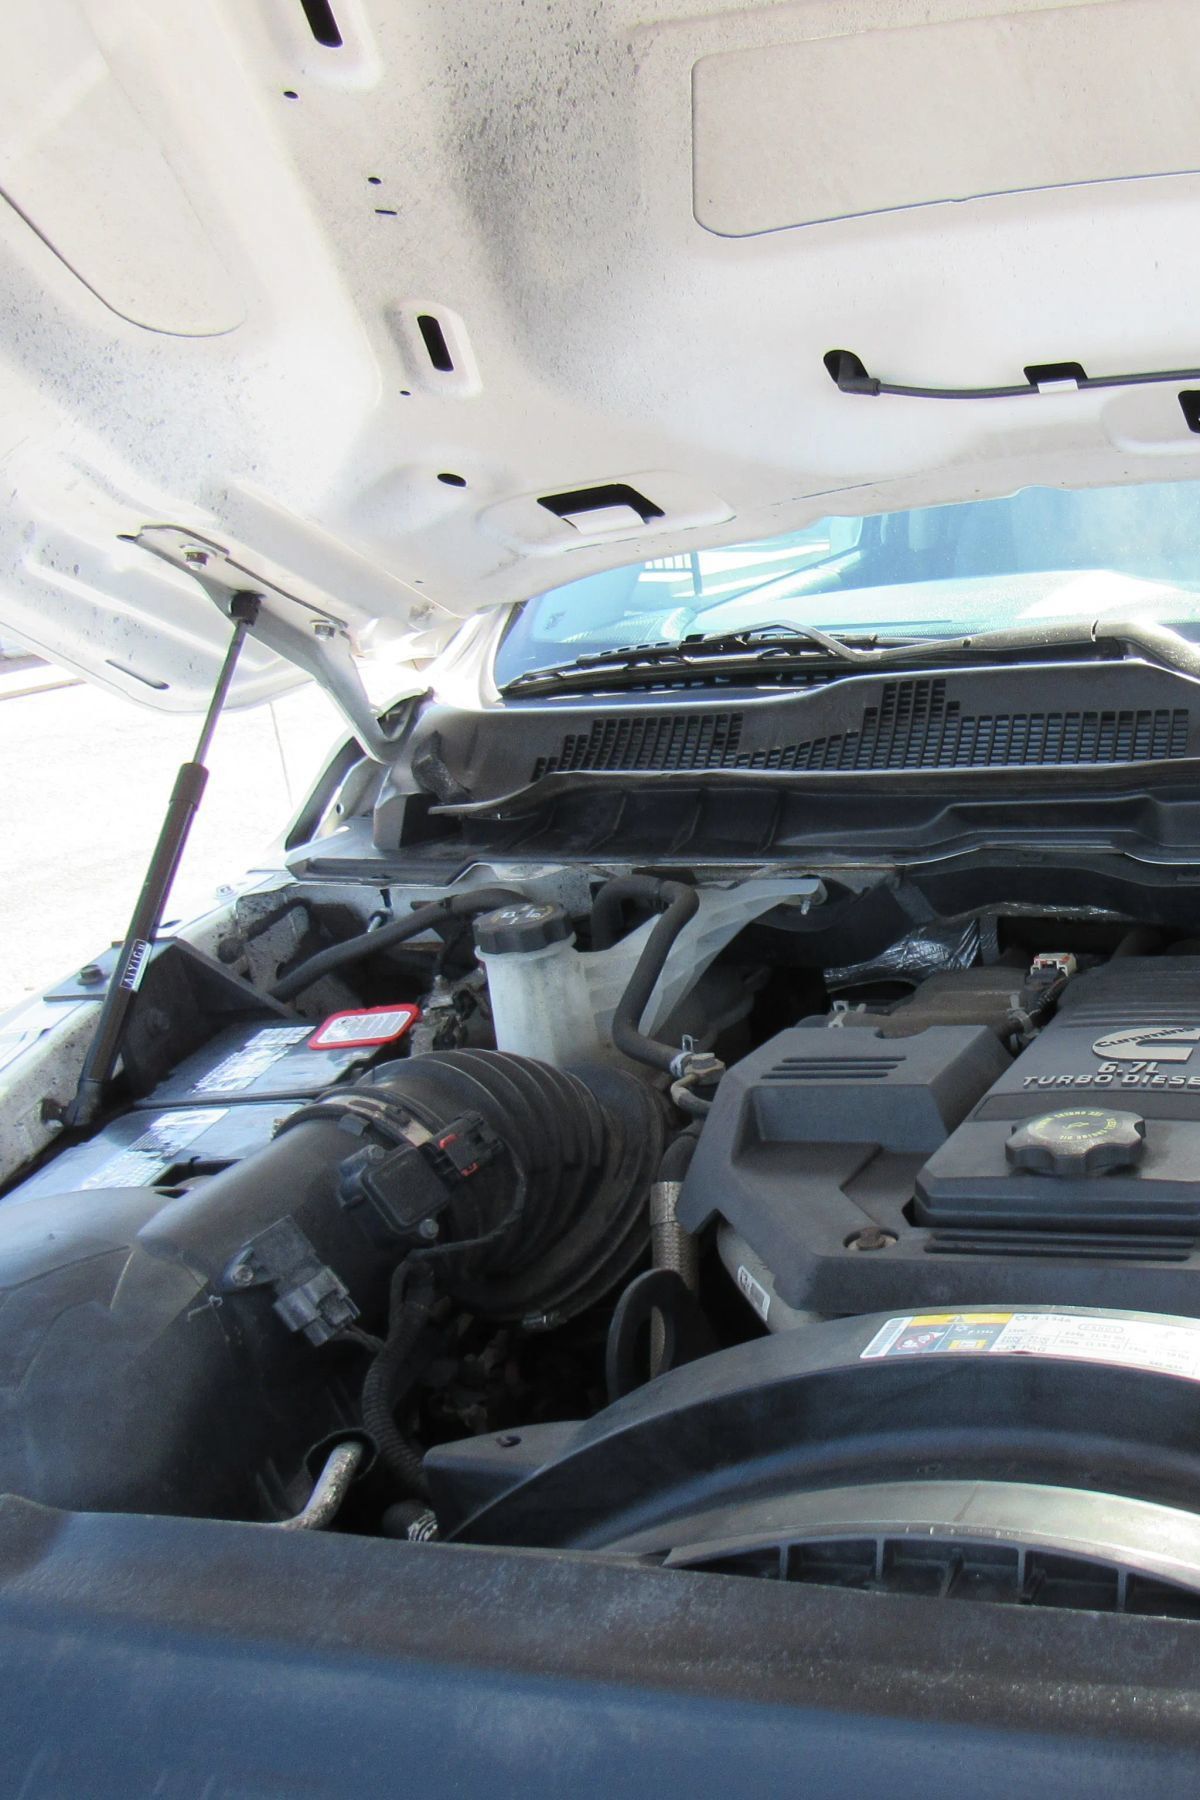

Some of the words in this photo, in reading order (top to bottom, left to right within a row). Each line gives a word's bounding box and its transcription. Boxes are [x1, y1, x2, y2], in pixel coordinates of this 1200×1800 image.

[1094, 1027, 1196, 1048] Cummins
[1097, 1061, 1160, 1075] 6.7L
[1023, 1074, 1114, 1087] TURBO
